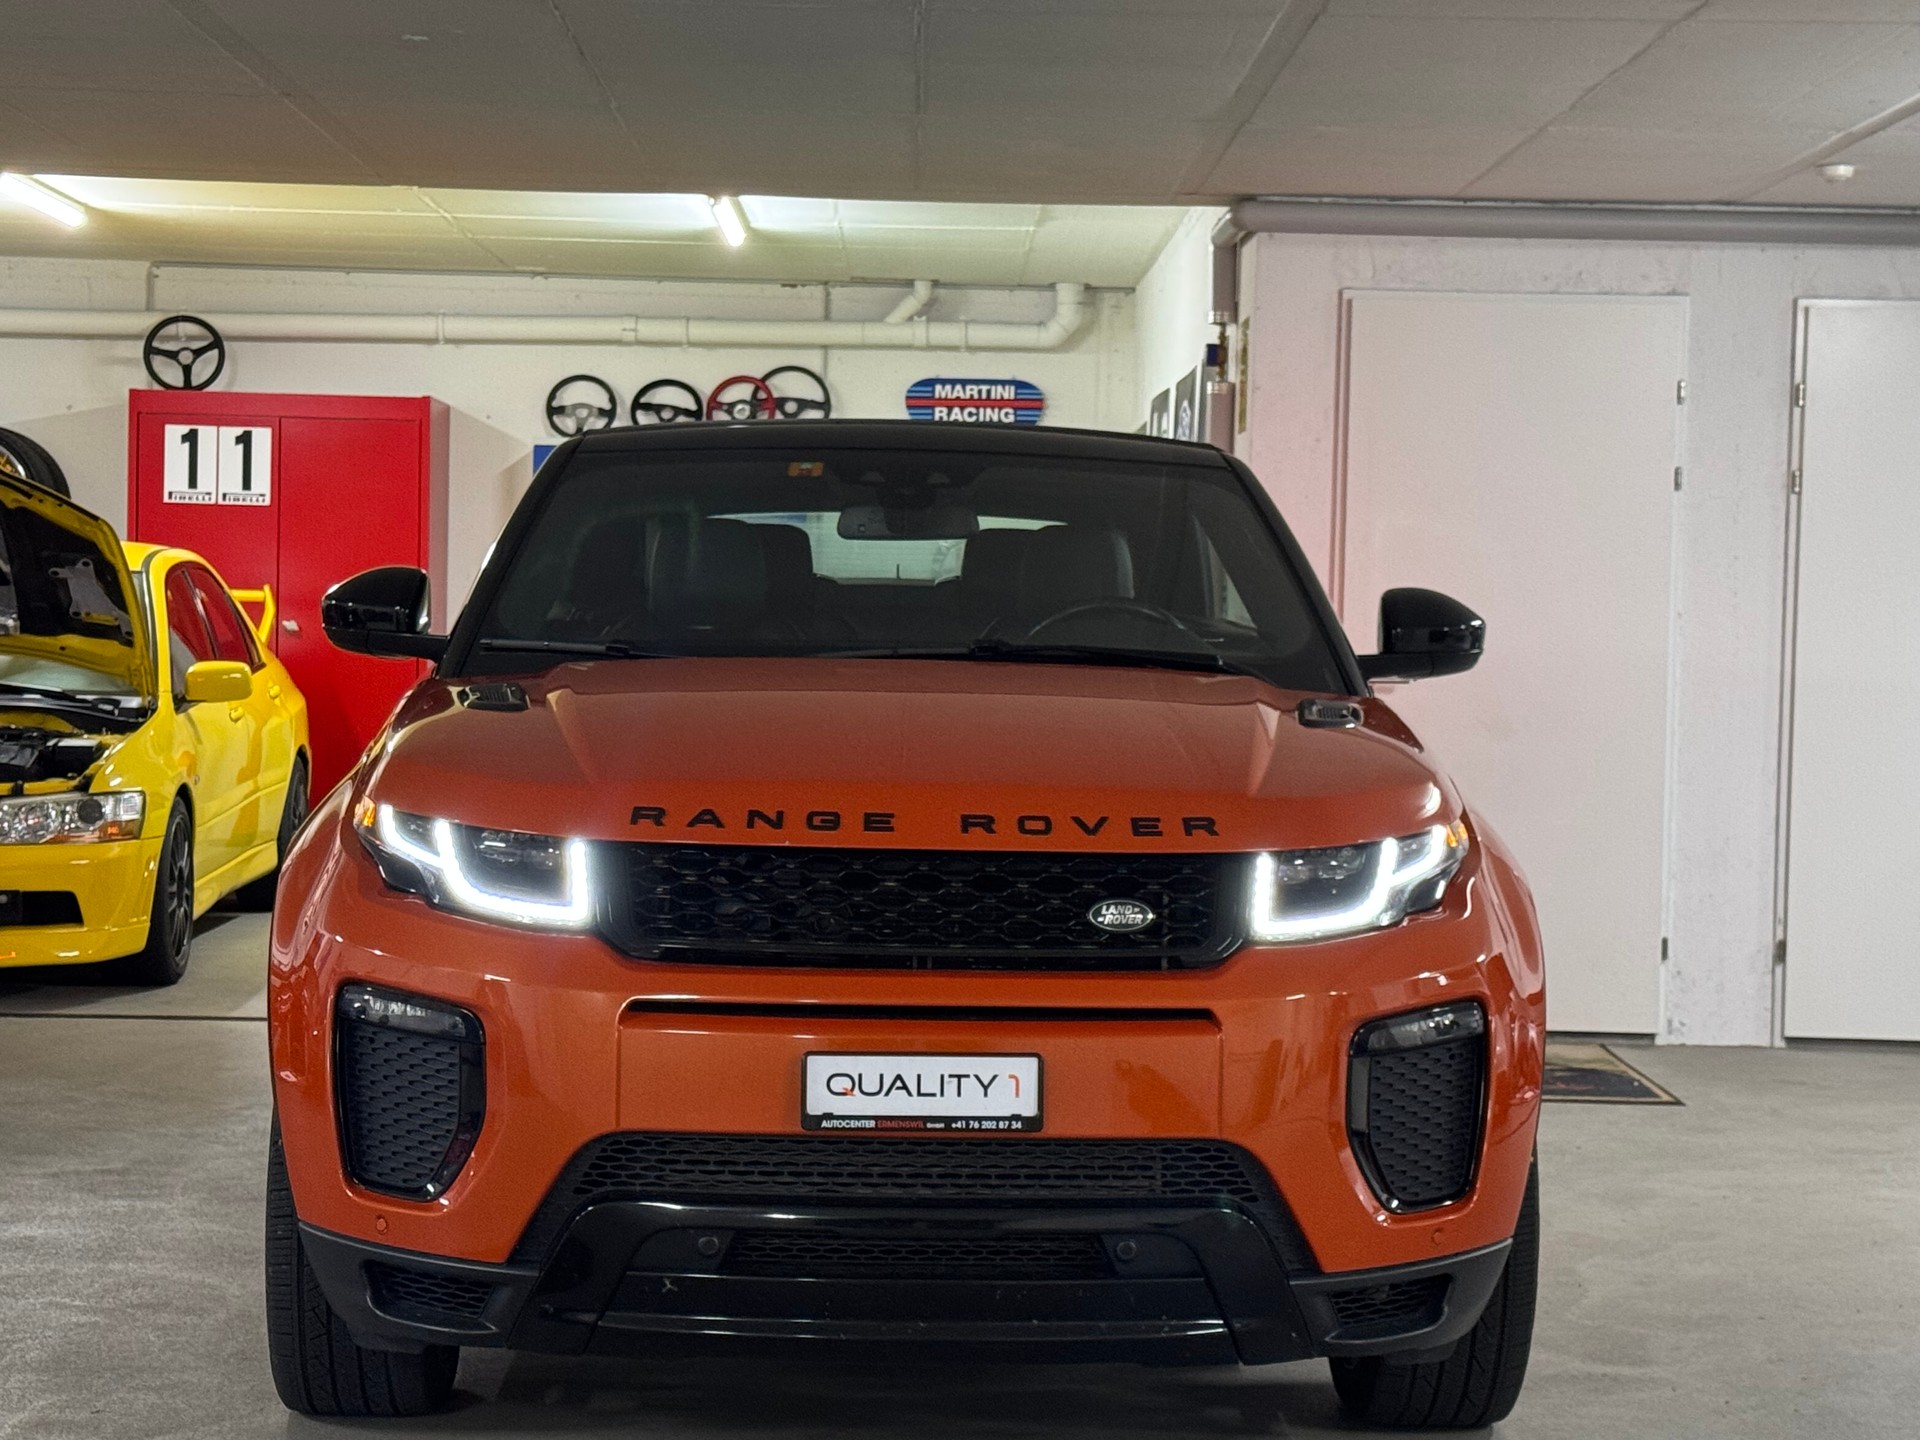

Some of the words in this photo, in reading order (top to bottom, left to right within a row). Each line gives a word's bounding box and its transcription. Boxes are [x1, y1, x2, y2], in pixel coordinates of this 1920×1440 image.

[934, 384, 1016, 399] MARTINI
[933, 407, 1015, 423] RACING
[630, 805, 895, 833] RANGE
[960, 813, 1220, 837] ROVER
[1101, 905, 1133, 915] LAND
[1104, 914, 1143, 925] ROVER
[826, 1072, 999, 1098] QUALITY
[821, 1119, 876, 1129] AUTOCENTER
[951, 1120, 966, 1129] +41
[968, 1120, 980, 1129] 76
[981, 1120, 997, 1129] 202
[998, 1120, 1010, 1129] 87
[1011, 1120, 1023, 1129] 34
